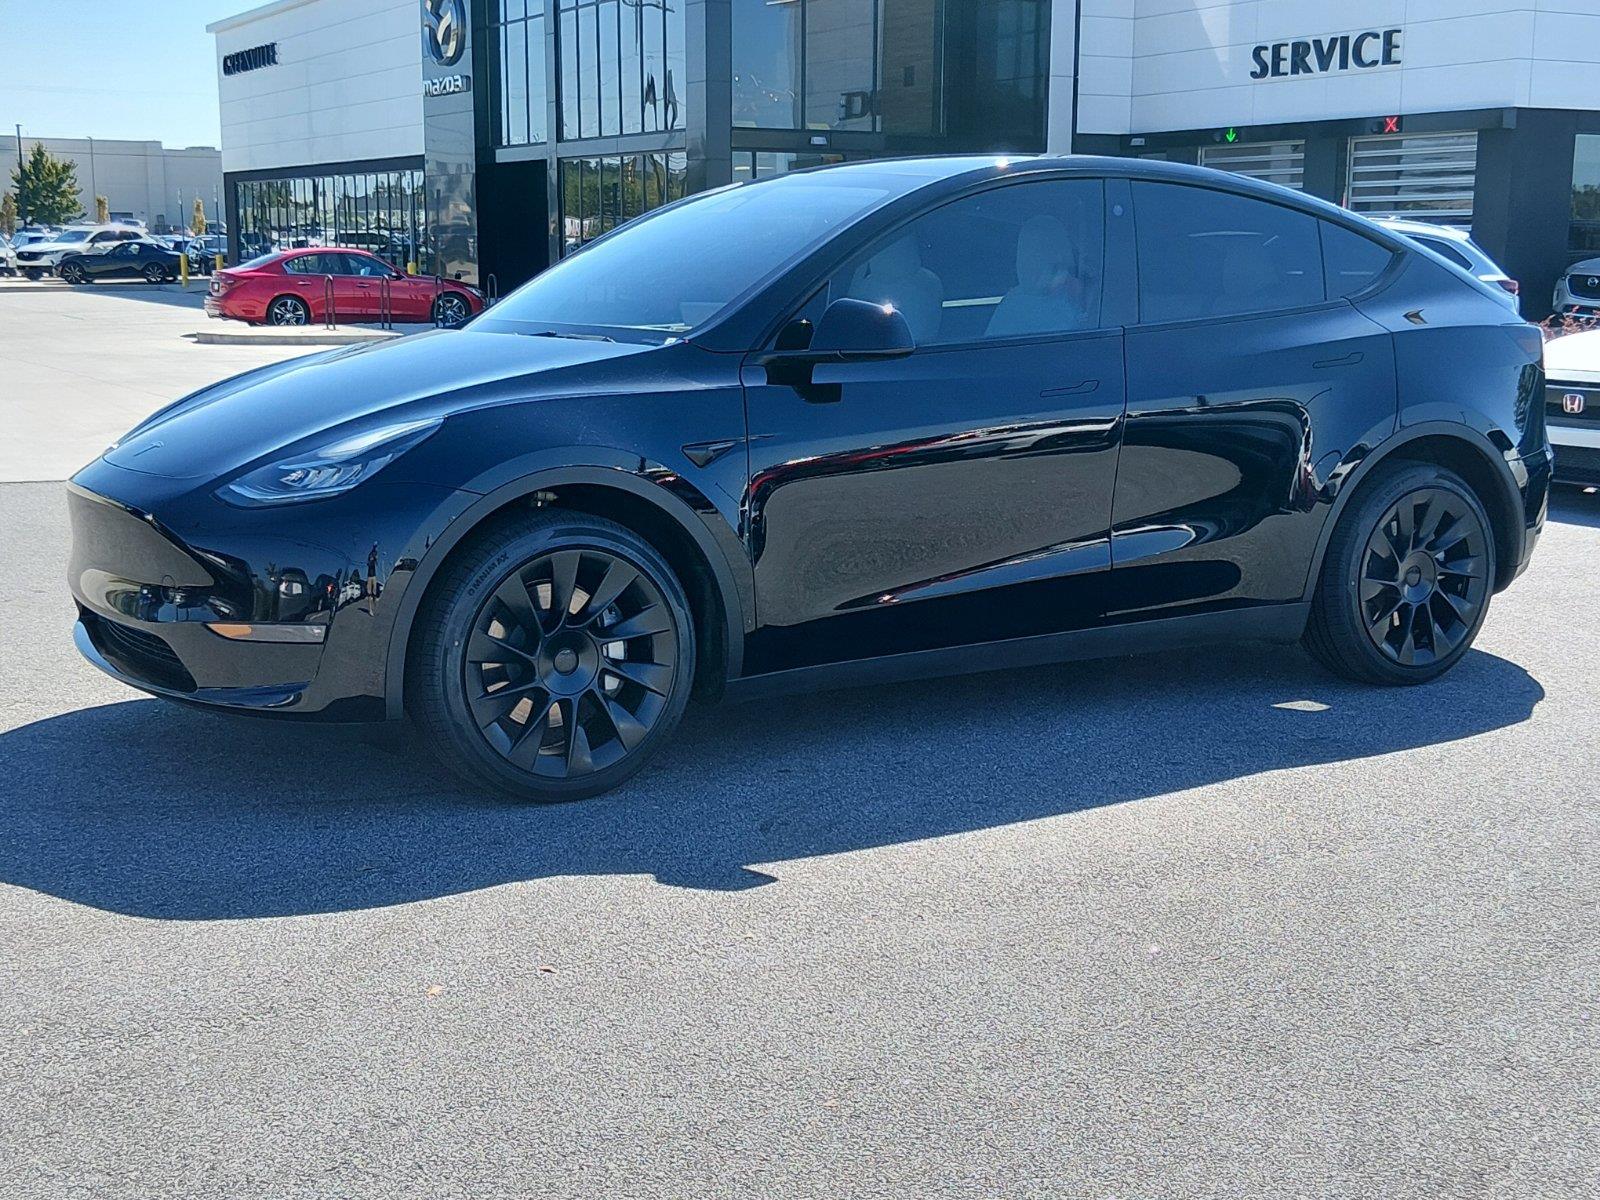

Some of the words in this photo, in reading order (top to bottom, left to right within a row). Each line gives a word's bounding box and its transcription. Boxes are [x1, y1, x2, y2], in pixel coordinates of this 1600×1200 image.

[1250, 29, 1402, 79] SERVICE
[423, 75, 471, 97] mazda
[468, 551, 509, 597] OMNIMAX
